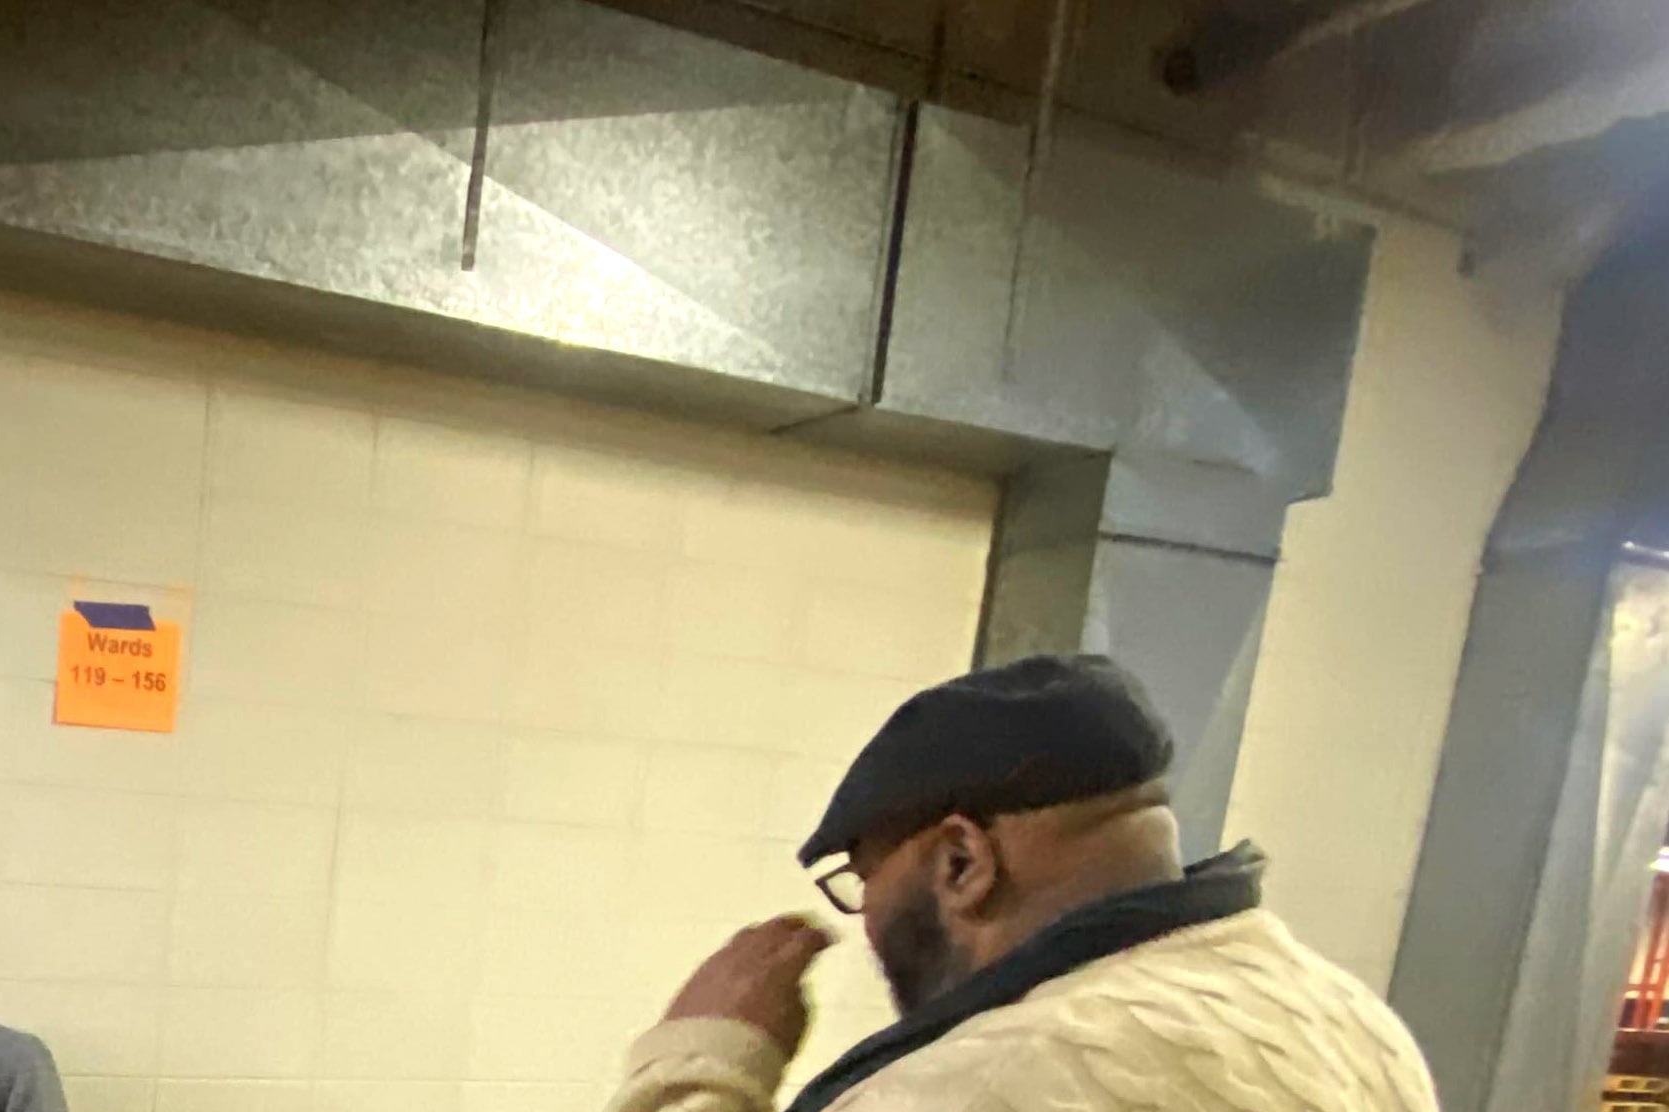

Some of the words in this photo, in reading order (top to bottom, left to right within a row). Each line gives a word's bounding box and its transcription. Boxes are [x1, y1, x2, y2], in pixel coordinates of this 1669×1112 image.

[87, 633, 153, 658] Wards
[71, 665, 106, 686] 119
[132, 671, 166, 692] 156
